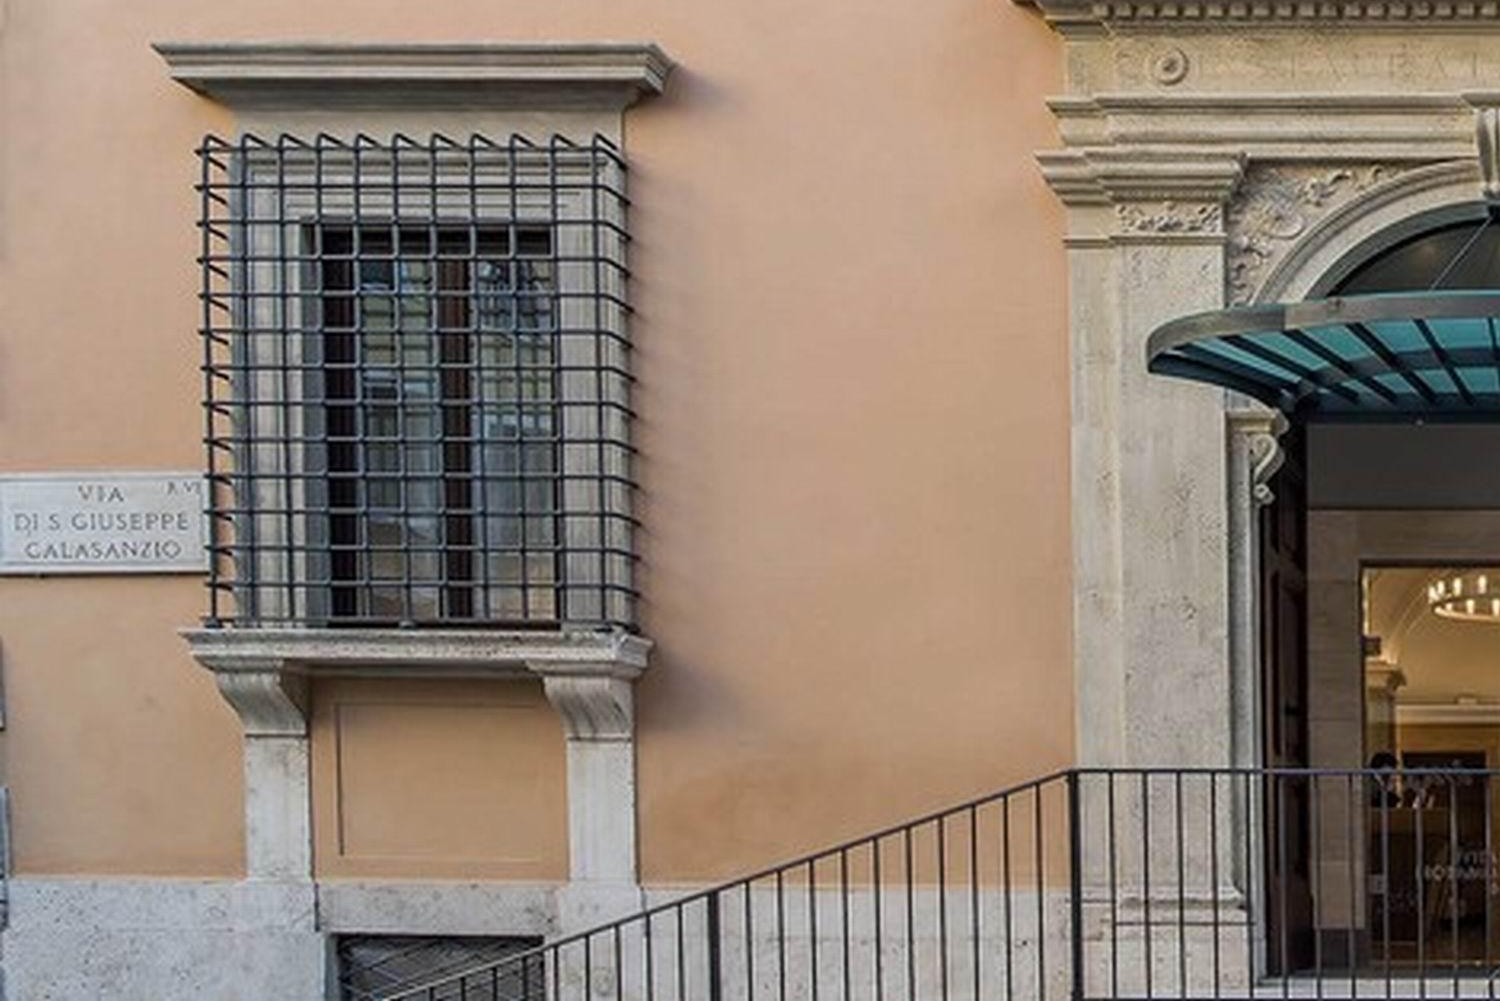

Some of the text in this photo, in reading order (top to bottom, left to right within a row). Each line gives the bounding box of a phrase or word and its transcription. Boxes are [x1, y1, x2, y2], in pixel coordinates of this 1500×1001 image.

[78, 485, 125, 502] VIA
[14, 513, 38, 531] DI
[71, 512, 189, 531] GIUSEPPE
[25, 539, 183, 560] CALASANZIO
